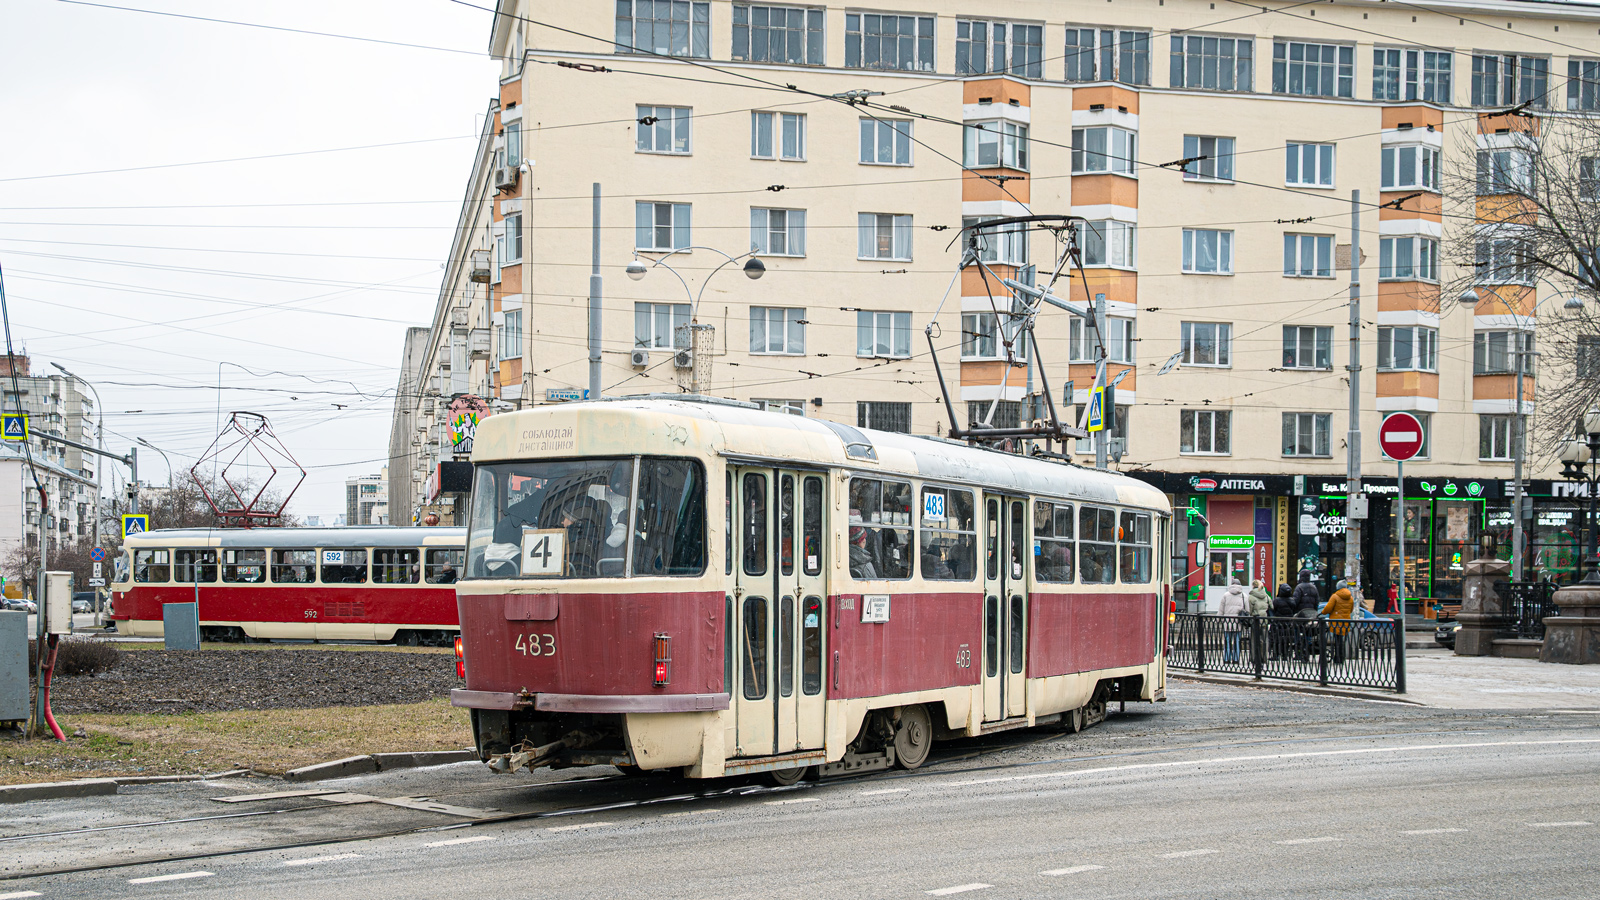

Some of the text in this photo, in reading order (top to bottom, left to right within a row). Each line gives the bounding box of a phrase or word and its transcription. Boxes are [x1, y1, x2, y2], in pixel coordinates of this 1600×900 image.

[1220, 480, 1265, 490] АПТЕКА
[1322, 483, 1339, 493] Еда.
[926, 495, 943, 515] 483
[1210, 537, 1252, 545] farmlend.ru
[326, 552, 341, 561] 592
[530, 536, 553, 568] 4
[304, 610, 318, 619] 592
[515, 633, 556, 657] 483
[955, 650, 971, 669] 483
